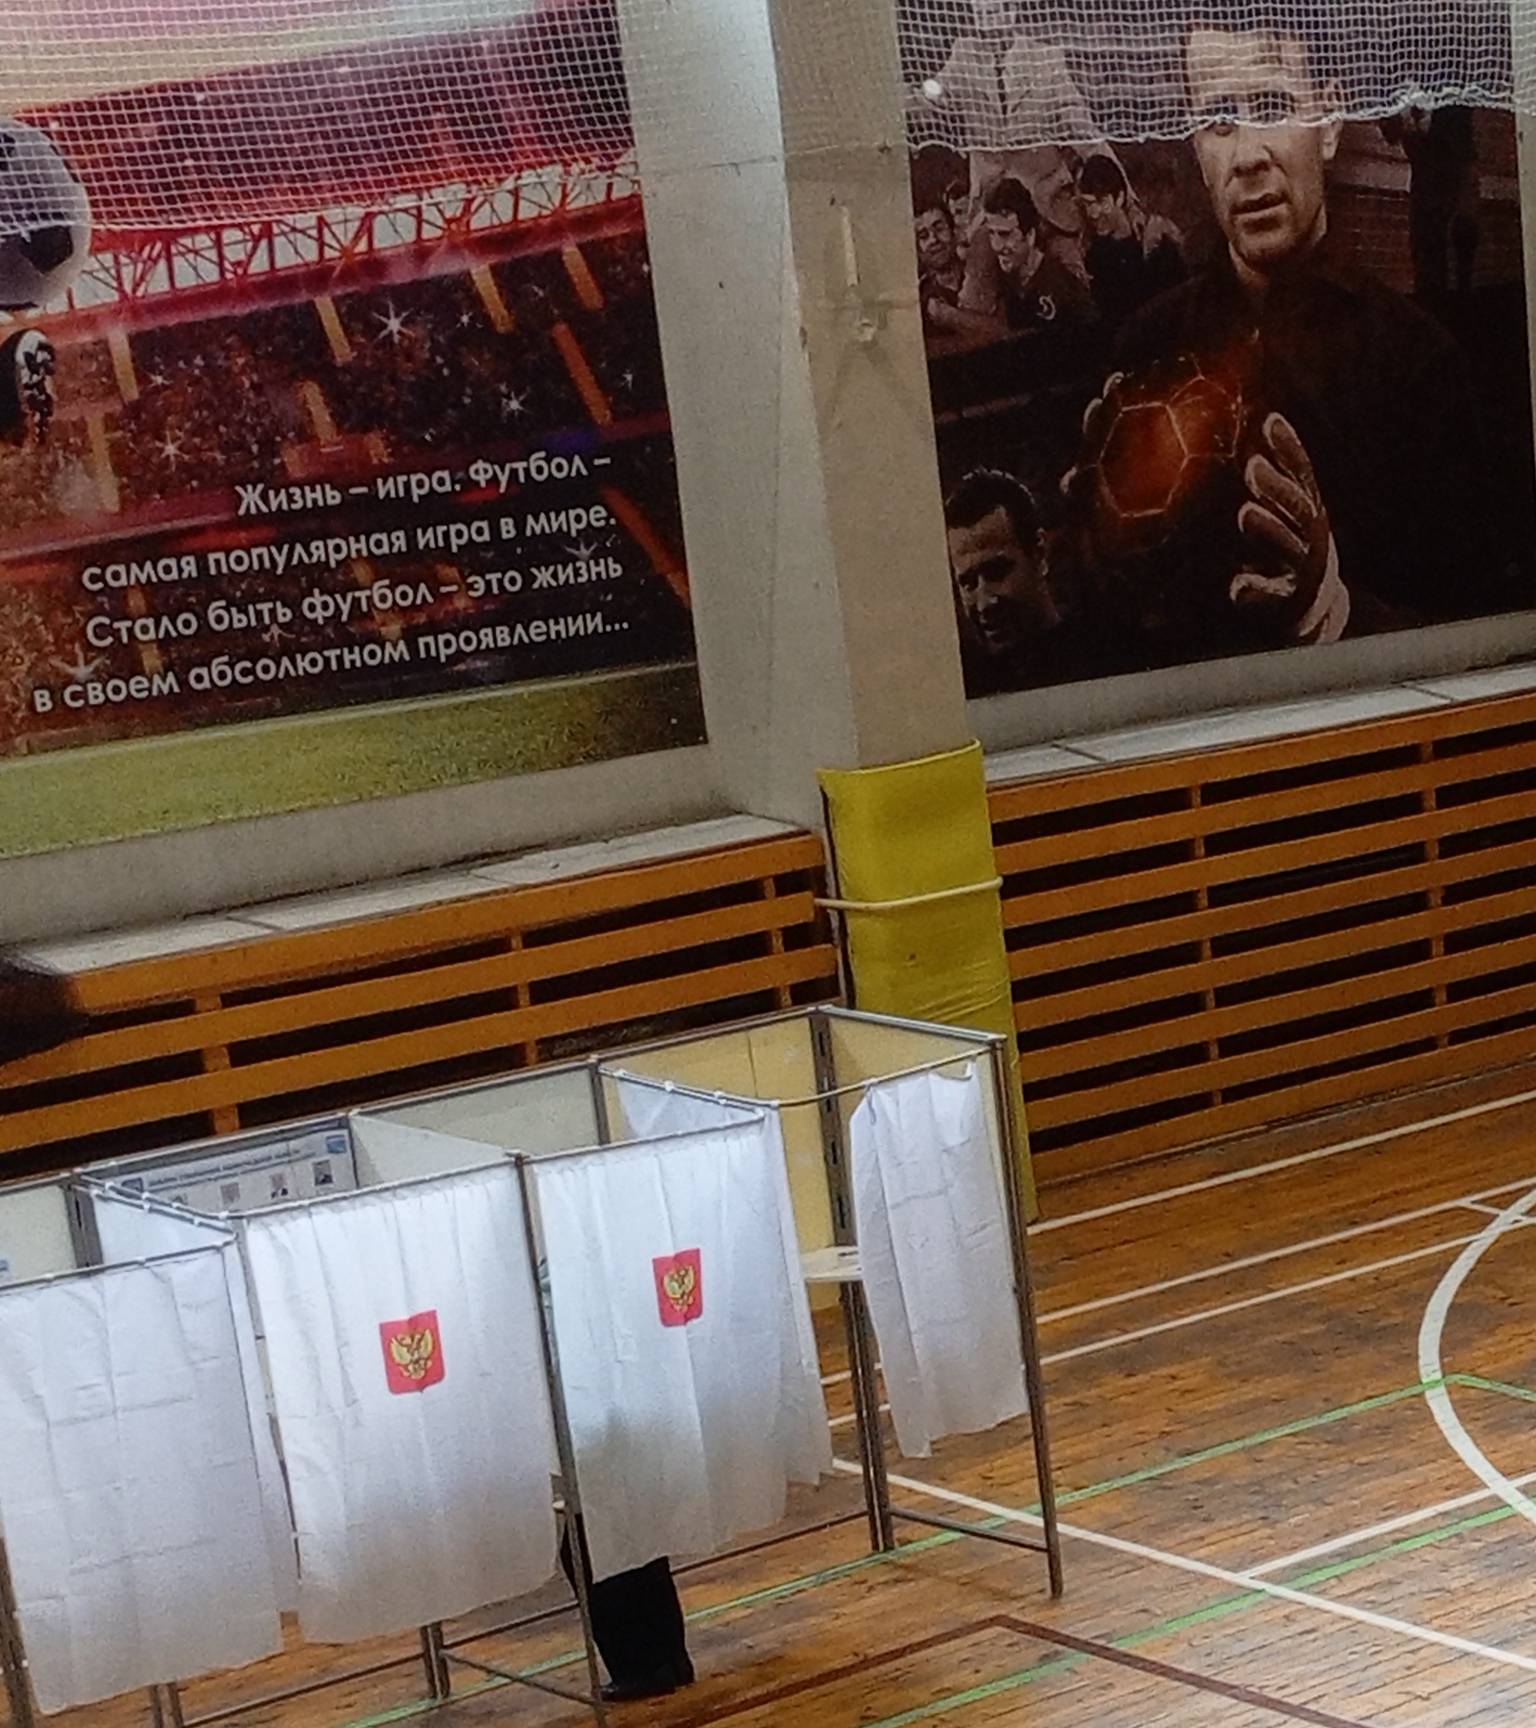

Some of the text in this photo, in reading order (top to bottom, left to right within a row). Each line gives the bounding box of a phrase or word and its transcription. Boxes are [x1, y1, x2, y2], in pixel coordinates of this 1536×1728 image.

[234, 483, 342, 516] Жизнь
[376, 469, 461, 503] игра.
[468, 450, 588, 494] Футбол
[81, 505, 617, 591] самая популярная игра в мире.
[86, 612, 198, 647] Стало
[207, 595, 292, 638] быть
[301, 578, 434, 625] футбол
[466, 570, 523, 598] это
[529, 556, 623, 589] жизнь
[33, 611, 629, 713] в своем абсолютном проявлении...
